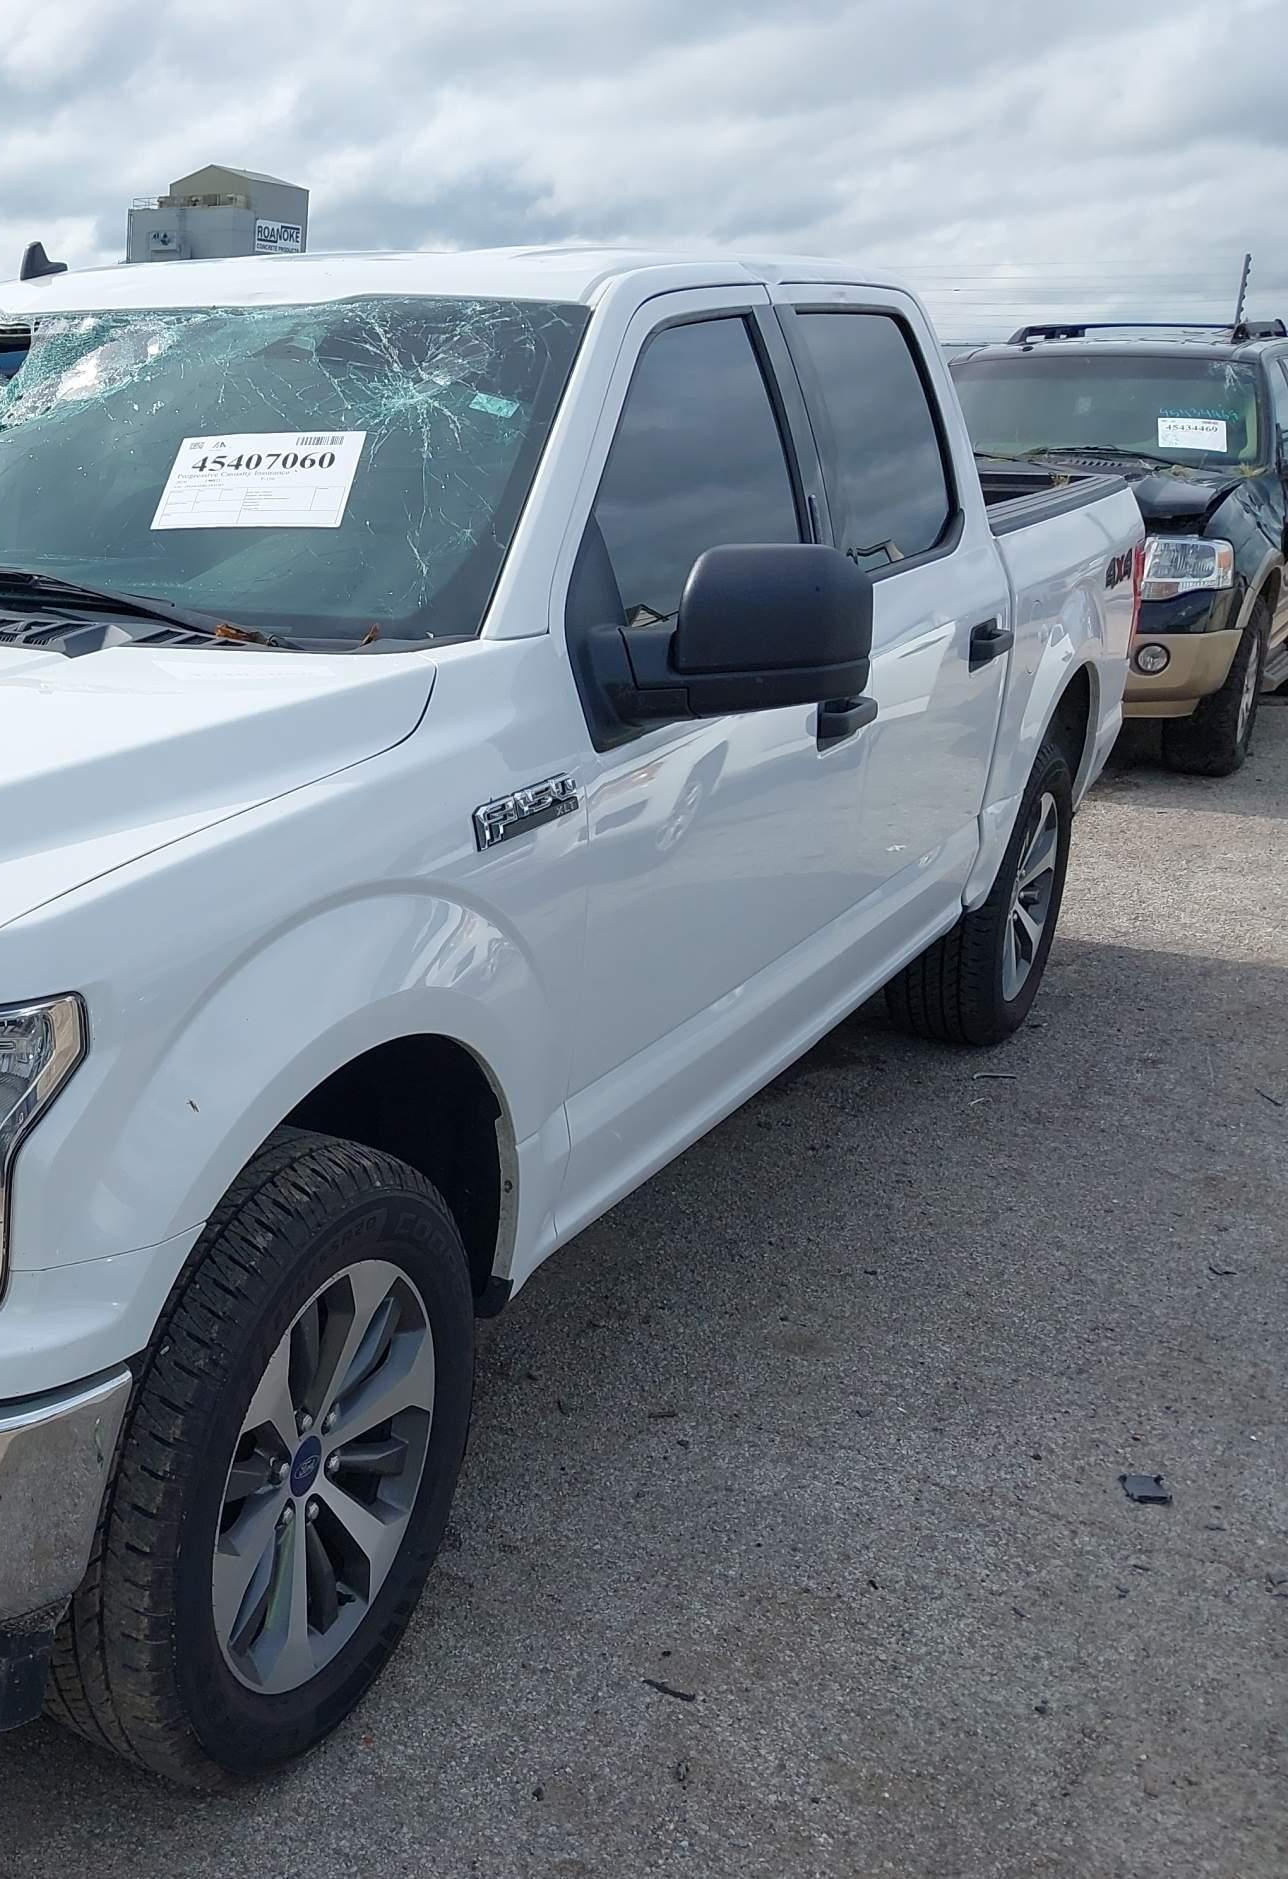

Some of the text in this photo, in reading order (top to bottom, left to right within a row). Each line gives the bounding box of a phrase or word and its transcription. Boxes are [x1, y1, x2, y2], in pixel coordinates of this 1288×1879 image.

[257, 225, 300, 243] ROANOKE
[257, 243, 278, 252] CONCRETE
[192, 452, 335, 472] 45407060
[555, 800, 577, 817] XLT
